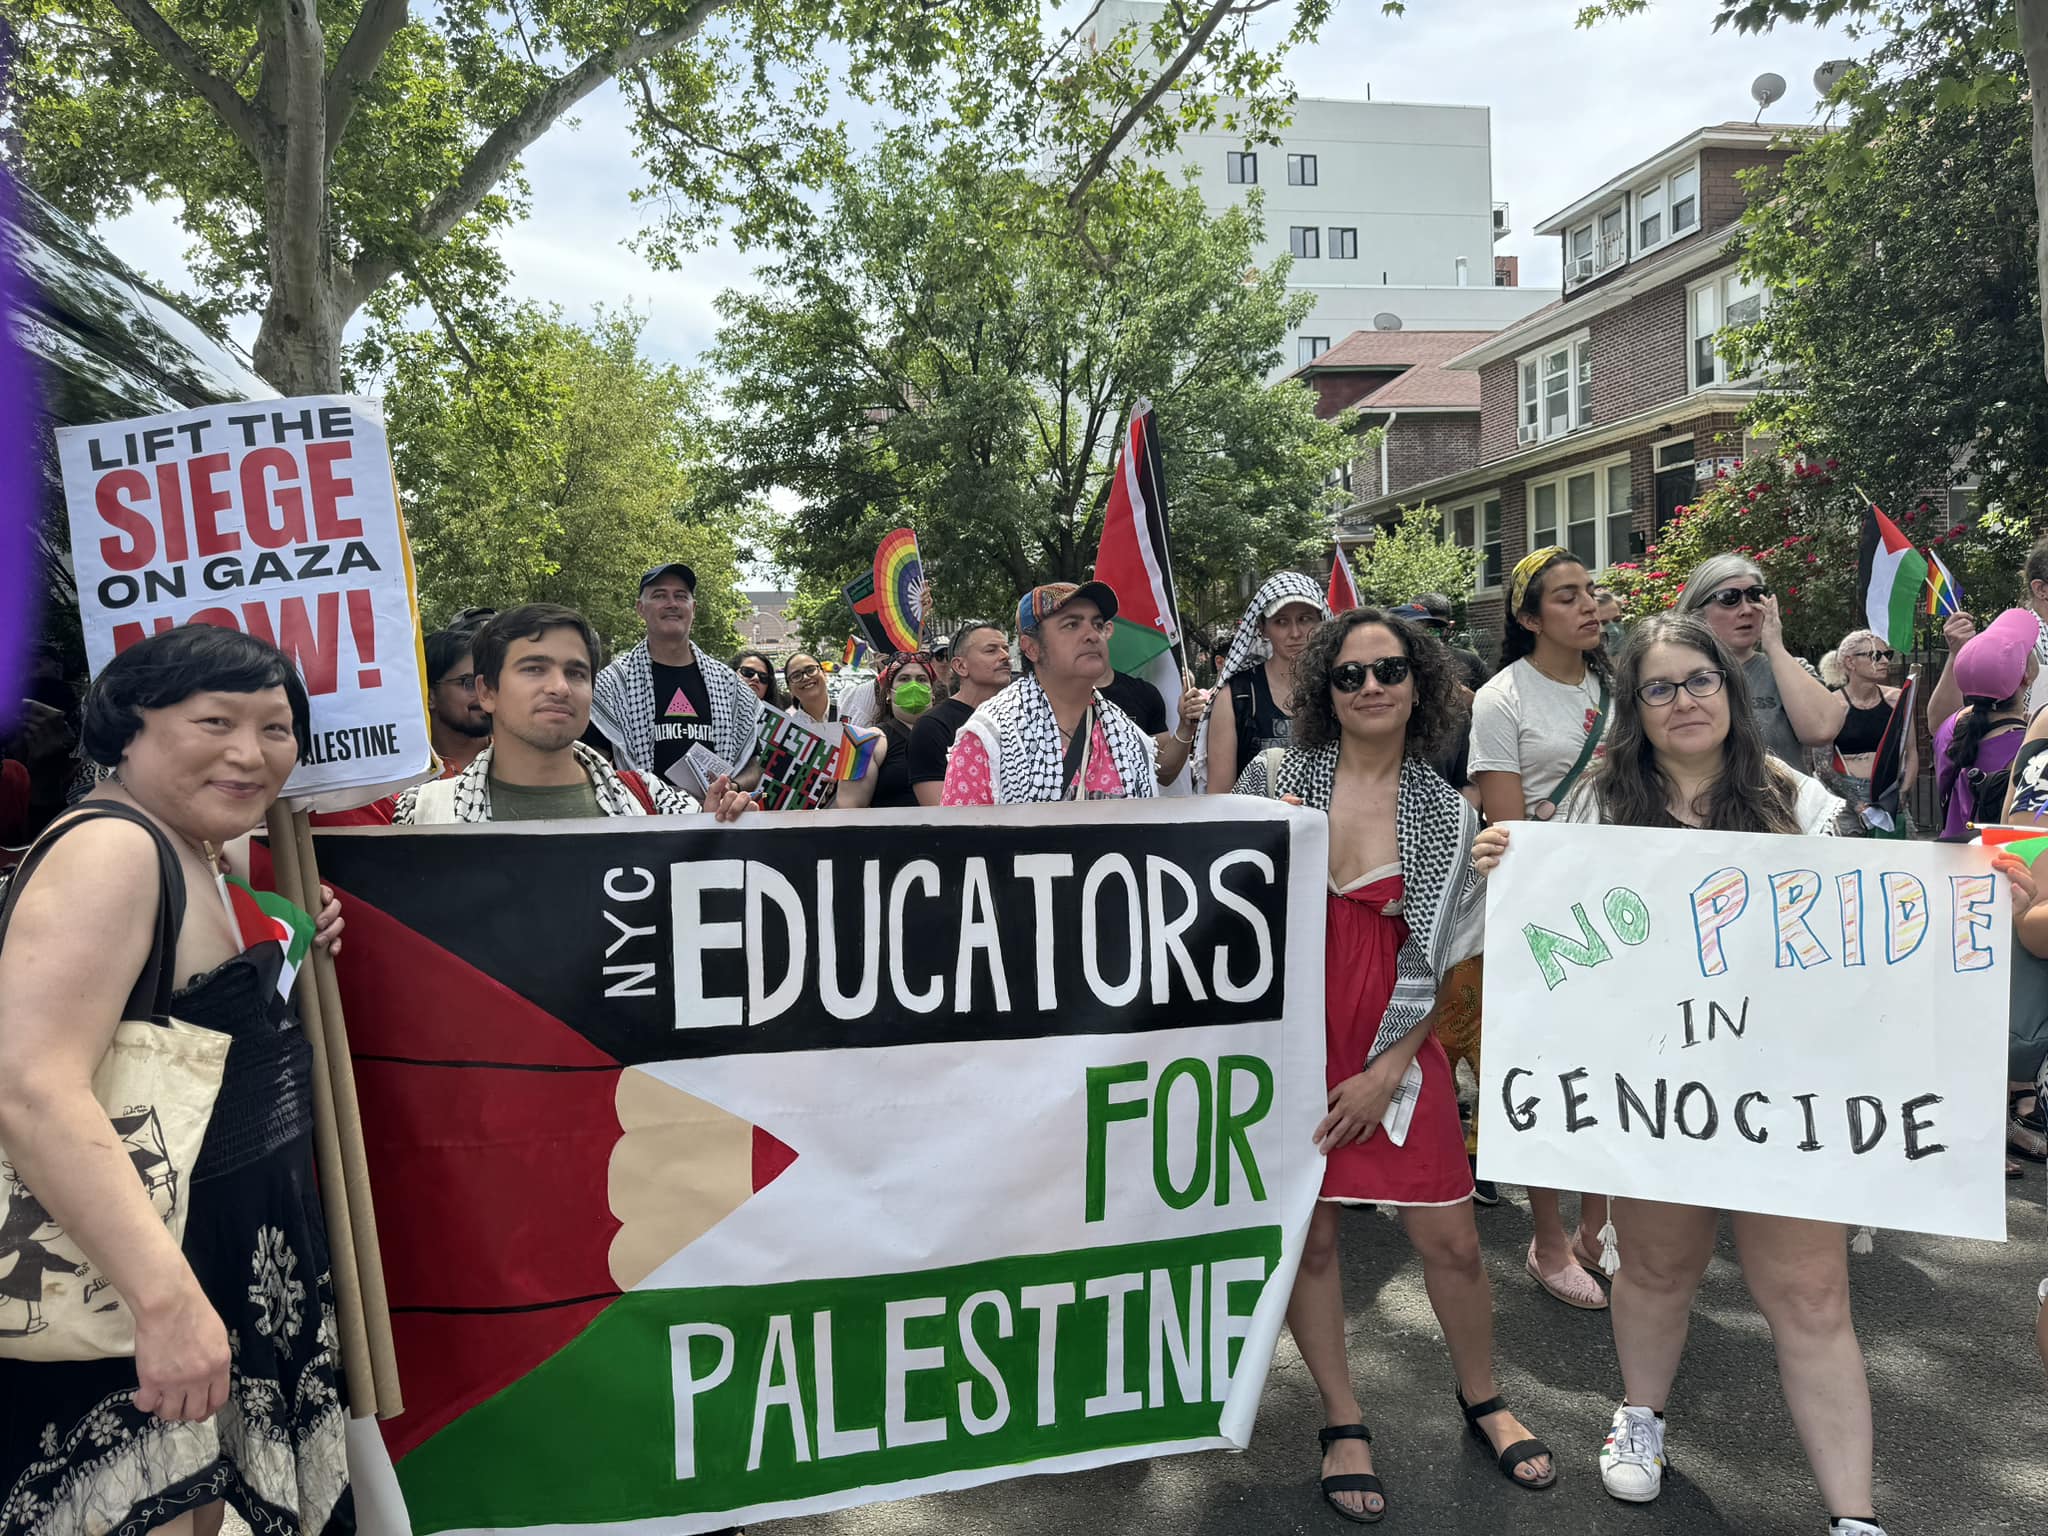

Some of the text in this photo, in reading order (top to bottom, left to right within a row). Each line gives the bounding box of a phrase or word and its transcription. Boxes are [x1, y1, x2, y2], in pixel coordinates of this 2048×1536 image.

[88, 407, 354, 470] LIFT THE
[95, 440, 363, 572] SIEGE
[97, 541, 381, 609] ON GAZA
[604, 866, 656, 999] NYC
[670, 850, 1274, 1030] EDUCATORS
[1523, 867, 1995, 990] NO PRIDE
[1677, 997, 1749, 1048] IN
[1085, 1054, 1274, 1223] FOR
[1503, 1067, 1947, 1160] GENOCIDE
[669, 1256, 1268, 1480] PALESTINE
